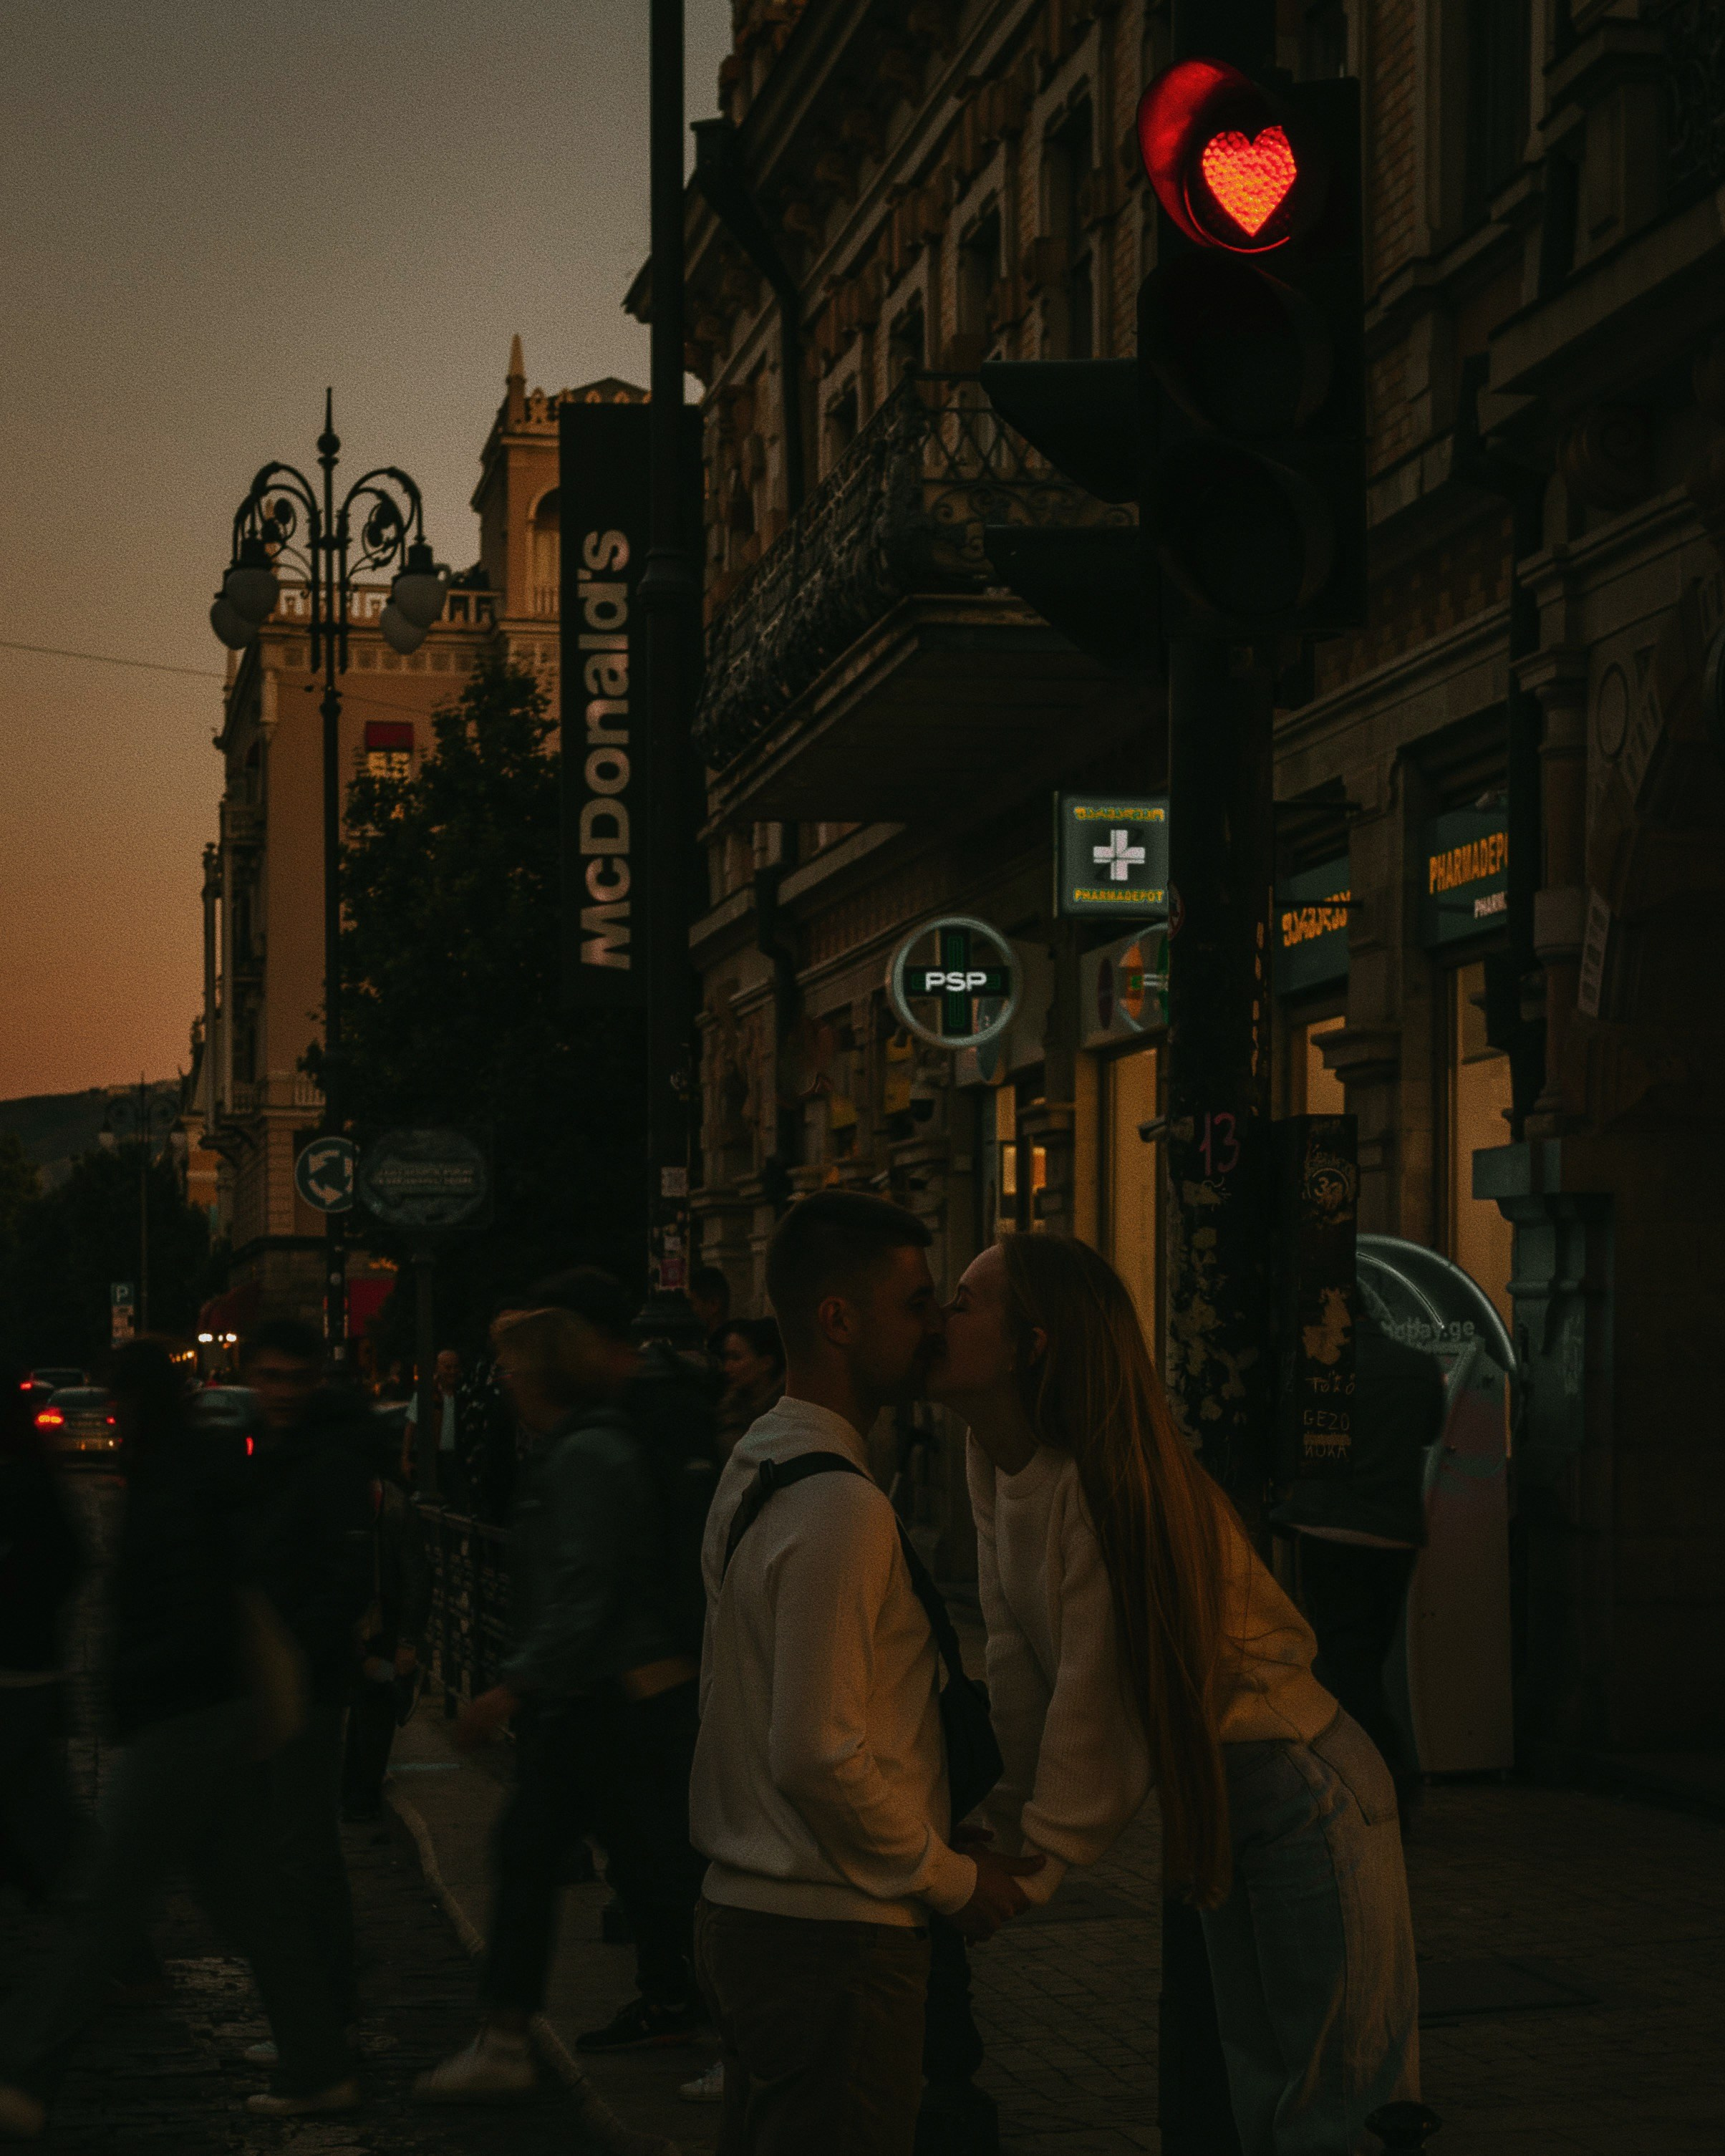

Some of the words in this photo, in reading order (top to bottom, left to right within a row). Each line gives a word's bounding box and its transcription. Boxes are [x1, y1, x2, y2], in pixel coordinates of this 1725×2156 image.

[577, 528, 632, 971] McDonald's
[1074, 888, 1164, 903] PHARMADEPOT
[925, 971, 987, 992] PSP
[1199, 1111, 1241, 1176] 13
